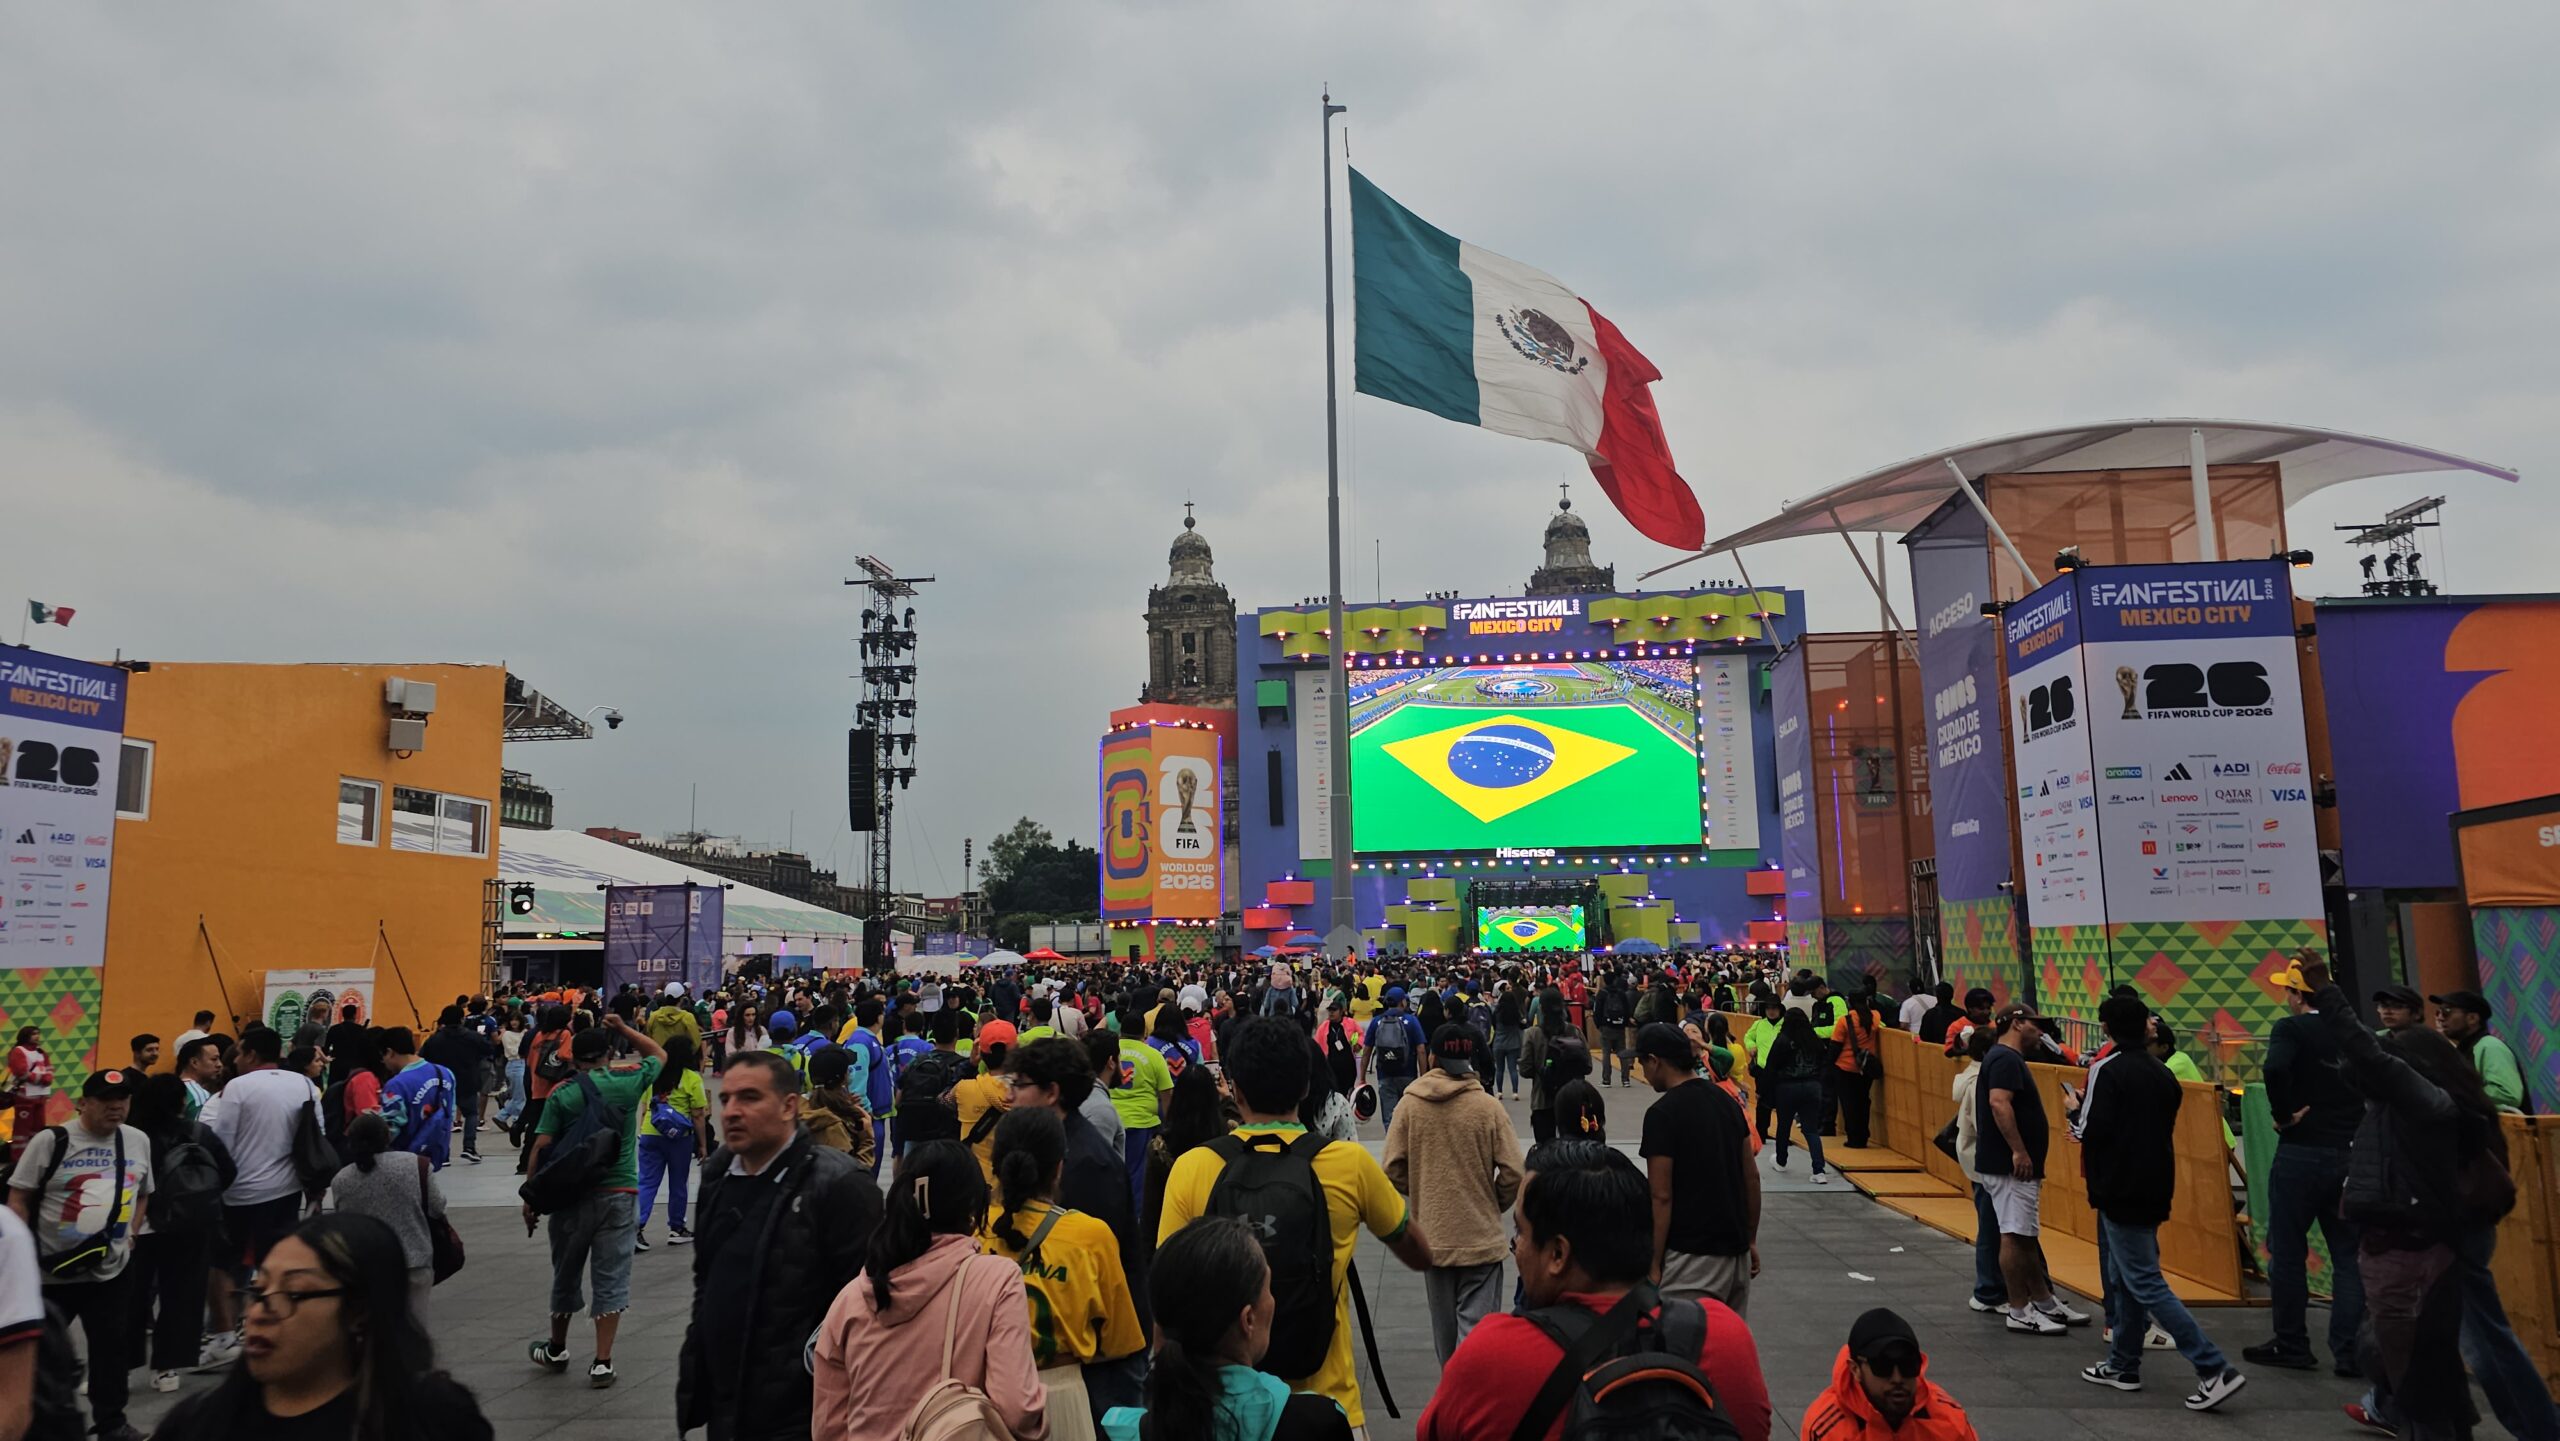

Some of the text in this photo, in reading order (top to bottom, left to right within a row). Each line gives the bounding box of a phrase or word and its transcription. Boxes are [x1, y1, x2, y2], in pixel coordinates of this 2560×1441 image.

[2090, 584, 2101, 606] FIFA
[2264, 578, 2274, 600] 2026
[1928, 592, 1974, 638] ACCESO
[2120, 604, 2252, 626] MEXICO CITY
[1469, 617, 1563, 635] MEXICO CITY
[2018, 620, 2064, 658] MEXICO CITY
[2143, 661, 2271, 709] 26
[10, 687, 101, 717] MEXICO CITY
[2028, 675, 2074, 732] 26
[2147, 707, 2273, 720] FIFA WORLD CUP 2026
[1937, 709, 1980, 746] CIUDAD DE
[1938, 735, 1982, 768] MÉXICO
[15, 740, 100, 786] 26
[2106, 769, 2141, 777] aramco
[2223, 763, 2250, 773] ADI
[2161, 794, 2199, 803] Lenovo
[2215, 789, 2307, 801] QATAR VISA
[1176, 838, 1200, 849] FIFA
[2257, 841, 2286, 849] verizon
[1496, 847, 1556, 858] Hisense
[85, 857, 107, 869] VISA
[1160, 863, 1215, 873] WORLD CUP
[1160, 875, 1215, 890] 2026
[87, 1148, 113, 1157] FIFA
[63, 1159, 110, 1169] WORLD
